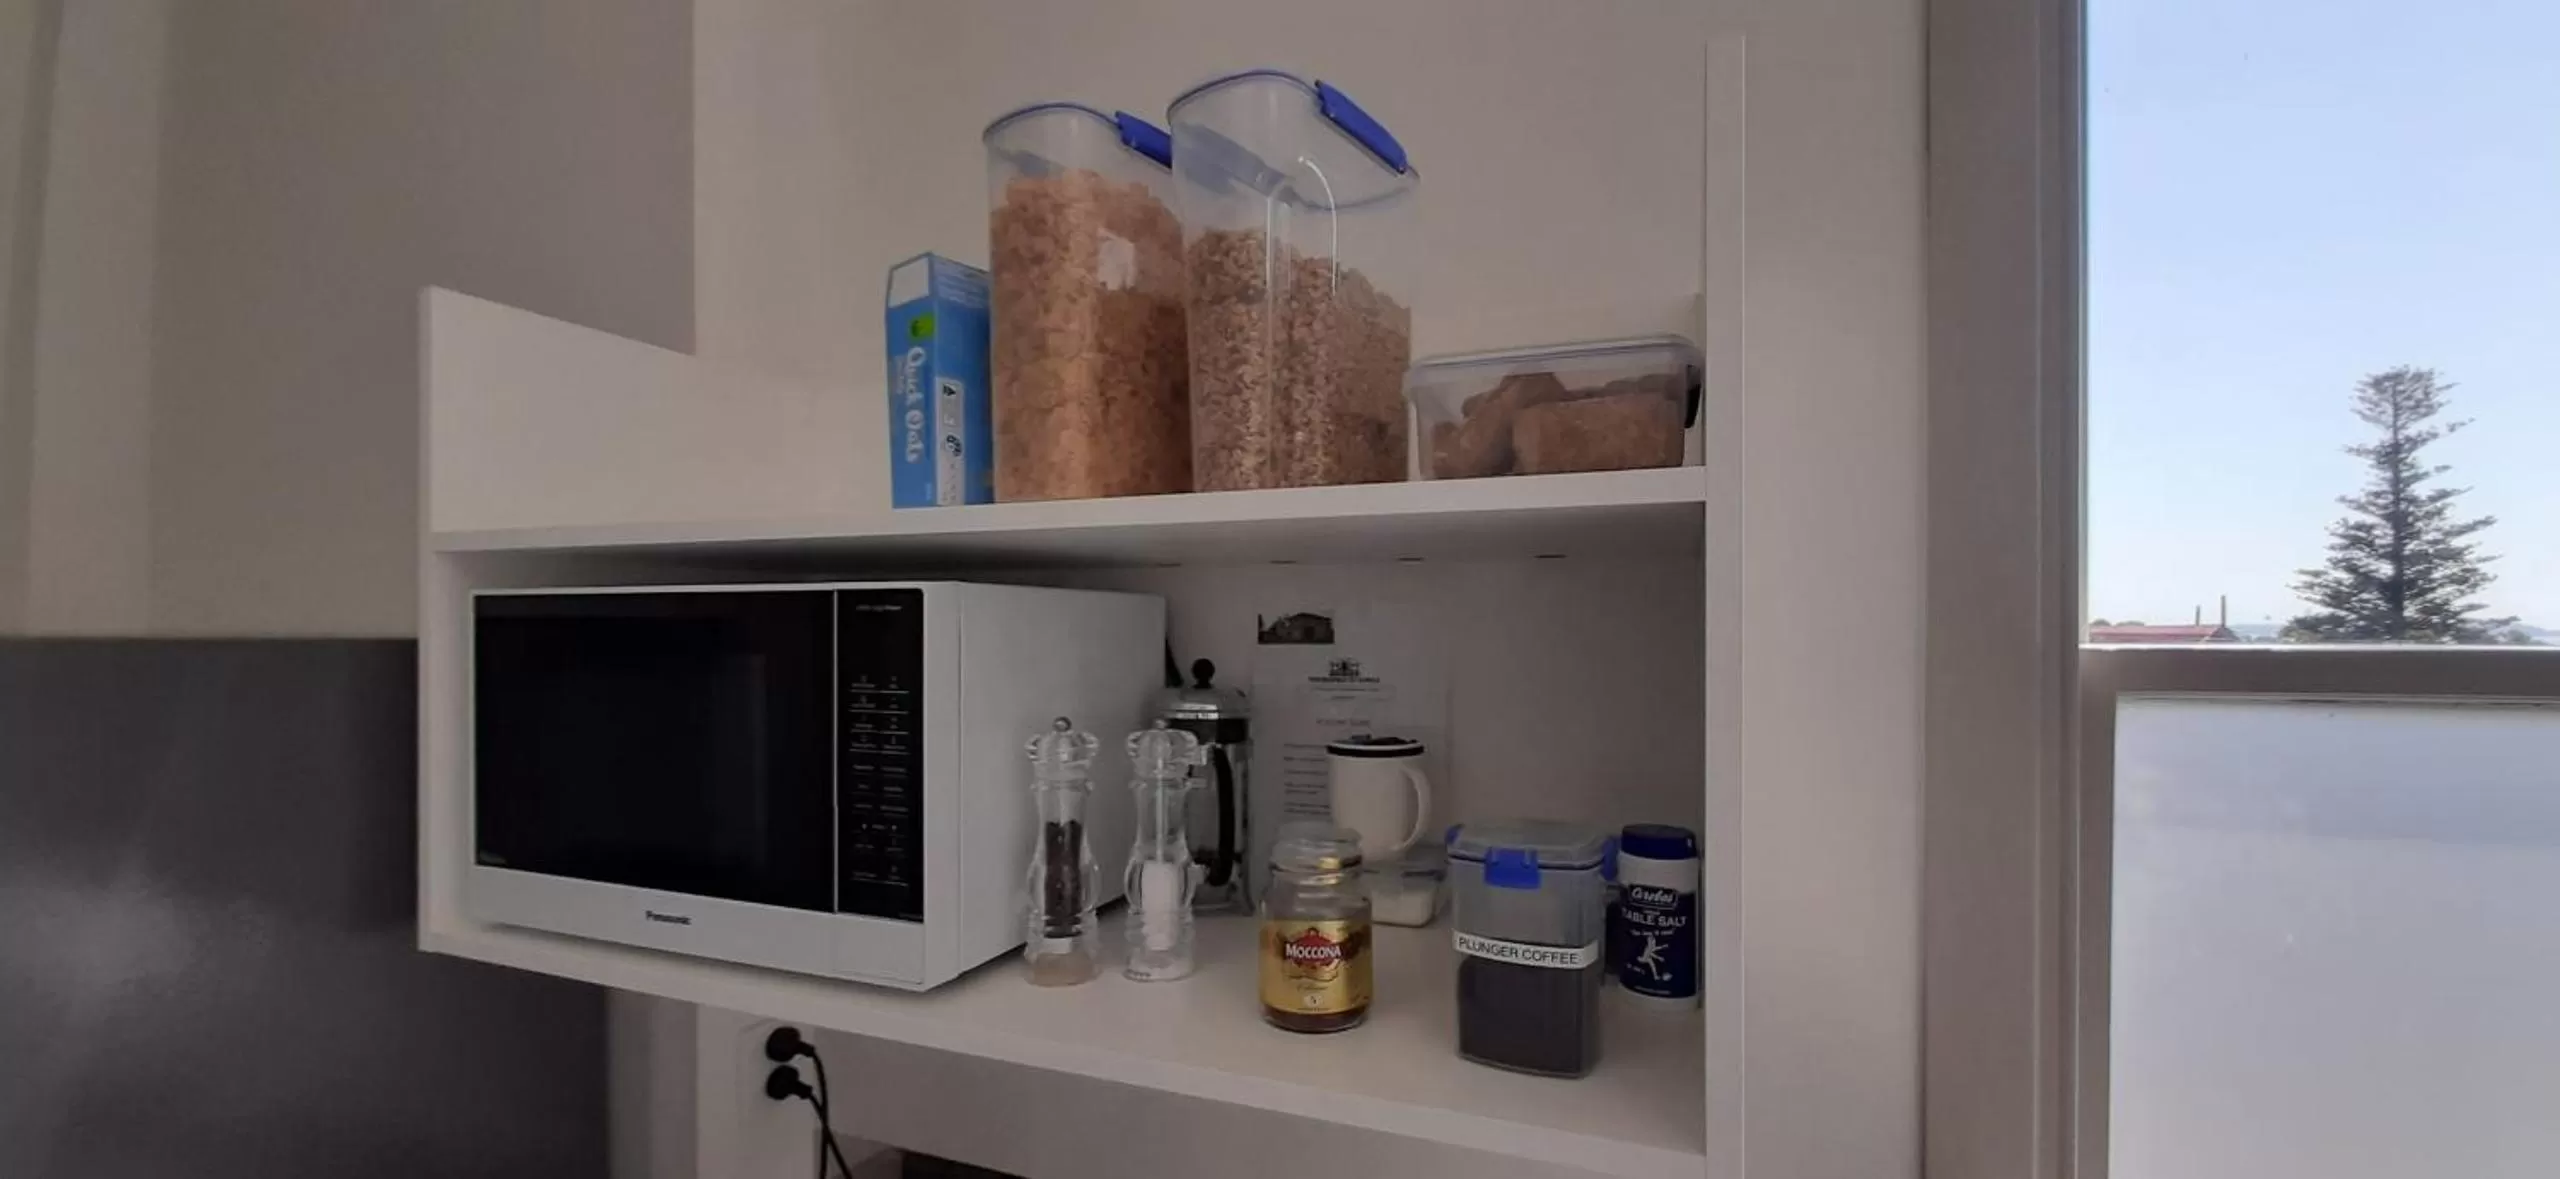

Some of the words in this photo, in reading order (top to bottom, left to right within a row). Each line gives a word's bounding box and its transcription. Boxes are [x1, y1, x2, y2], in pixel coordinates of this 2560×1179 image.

[1621, 906, 1656, 926] TABLE
[1658, 915, 1687, 928] SALT
[1286, 943, 1342, 960] MOCCONA
[1458, 936, 1519, 959] PLUNGER
[1521, 947, 1579, 965] COFFEE
